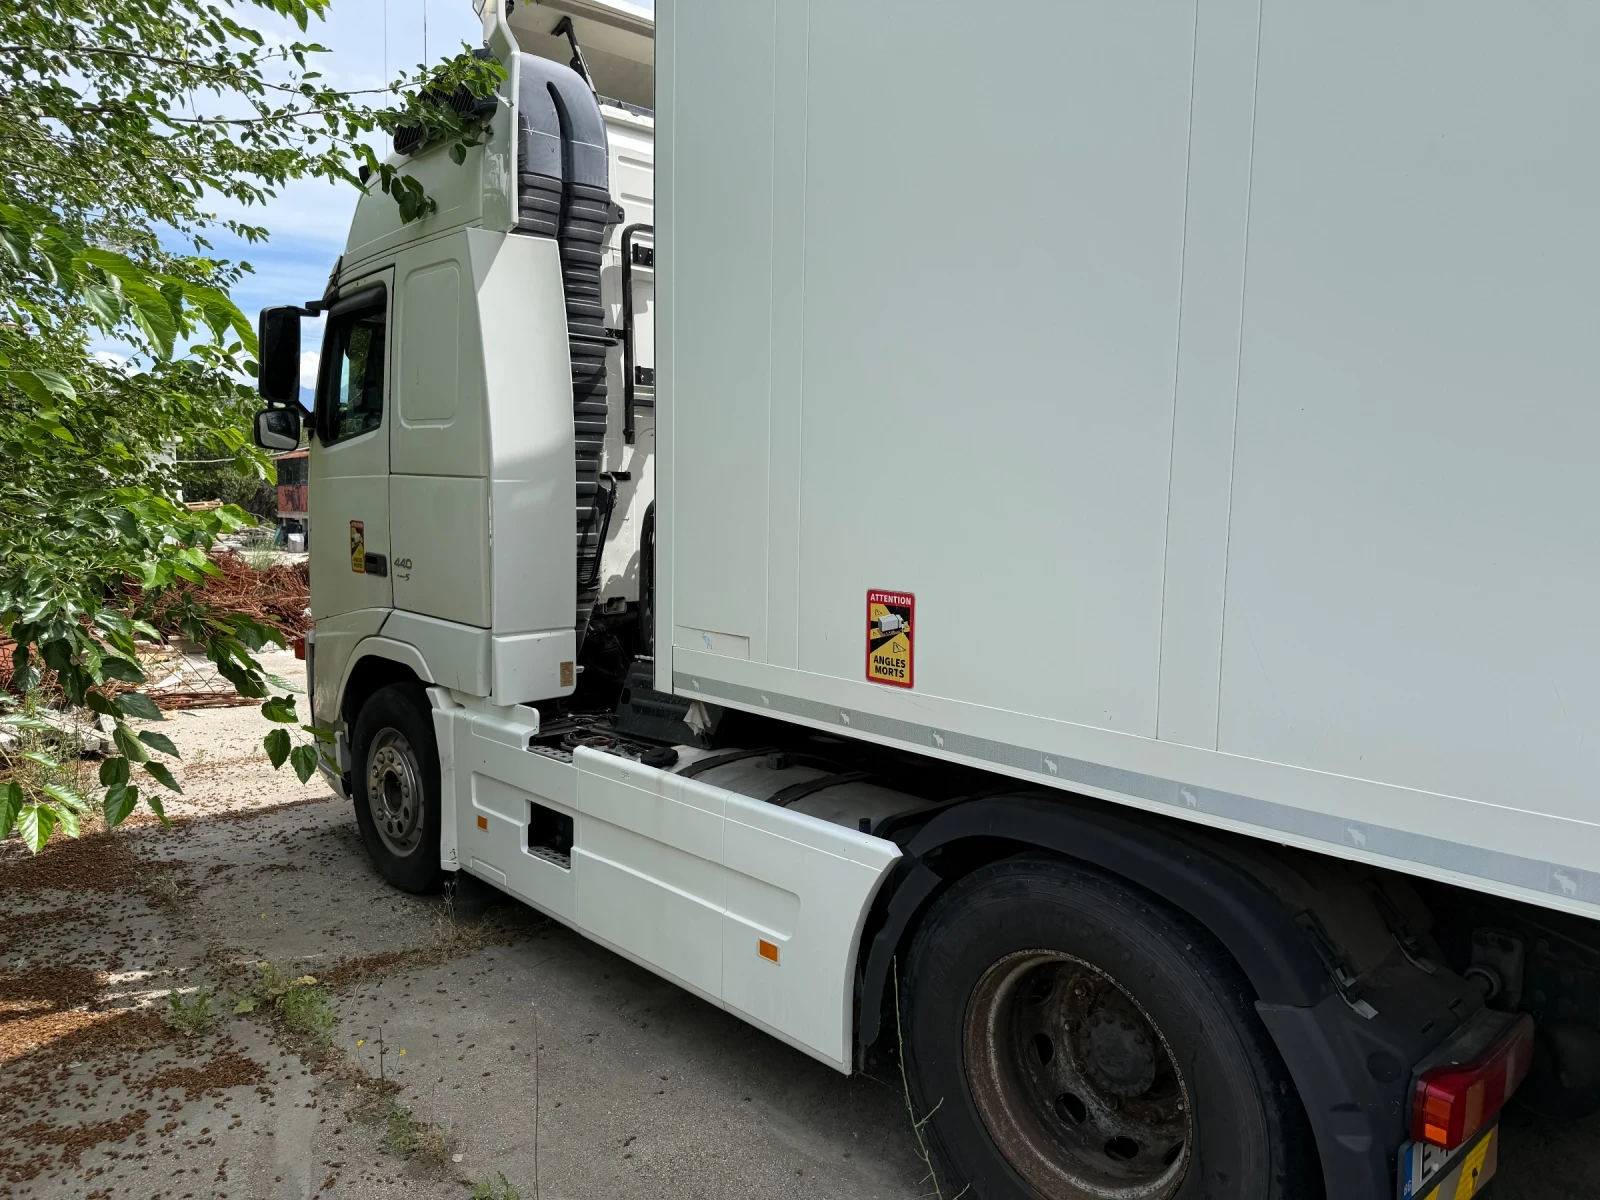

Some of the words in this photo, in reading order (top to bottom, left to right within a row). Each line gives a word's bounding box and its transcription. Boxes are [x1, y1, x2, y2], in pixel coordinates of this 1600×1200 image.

[394, 557, 413, 570] 440
[870, 593, 911, 605] ATTENTION
[873, 655, 906, 668] ANGLES
[874, 665, 904, 679] MORTS
